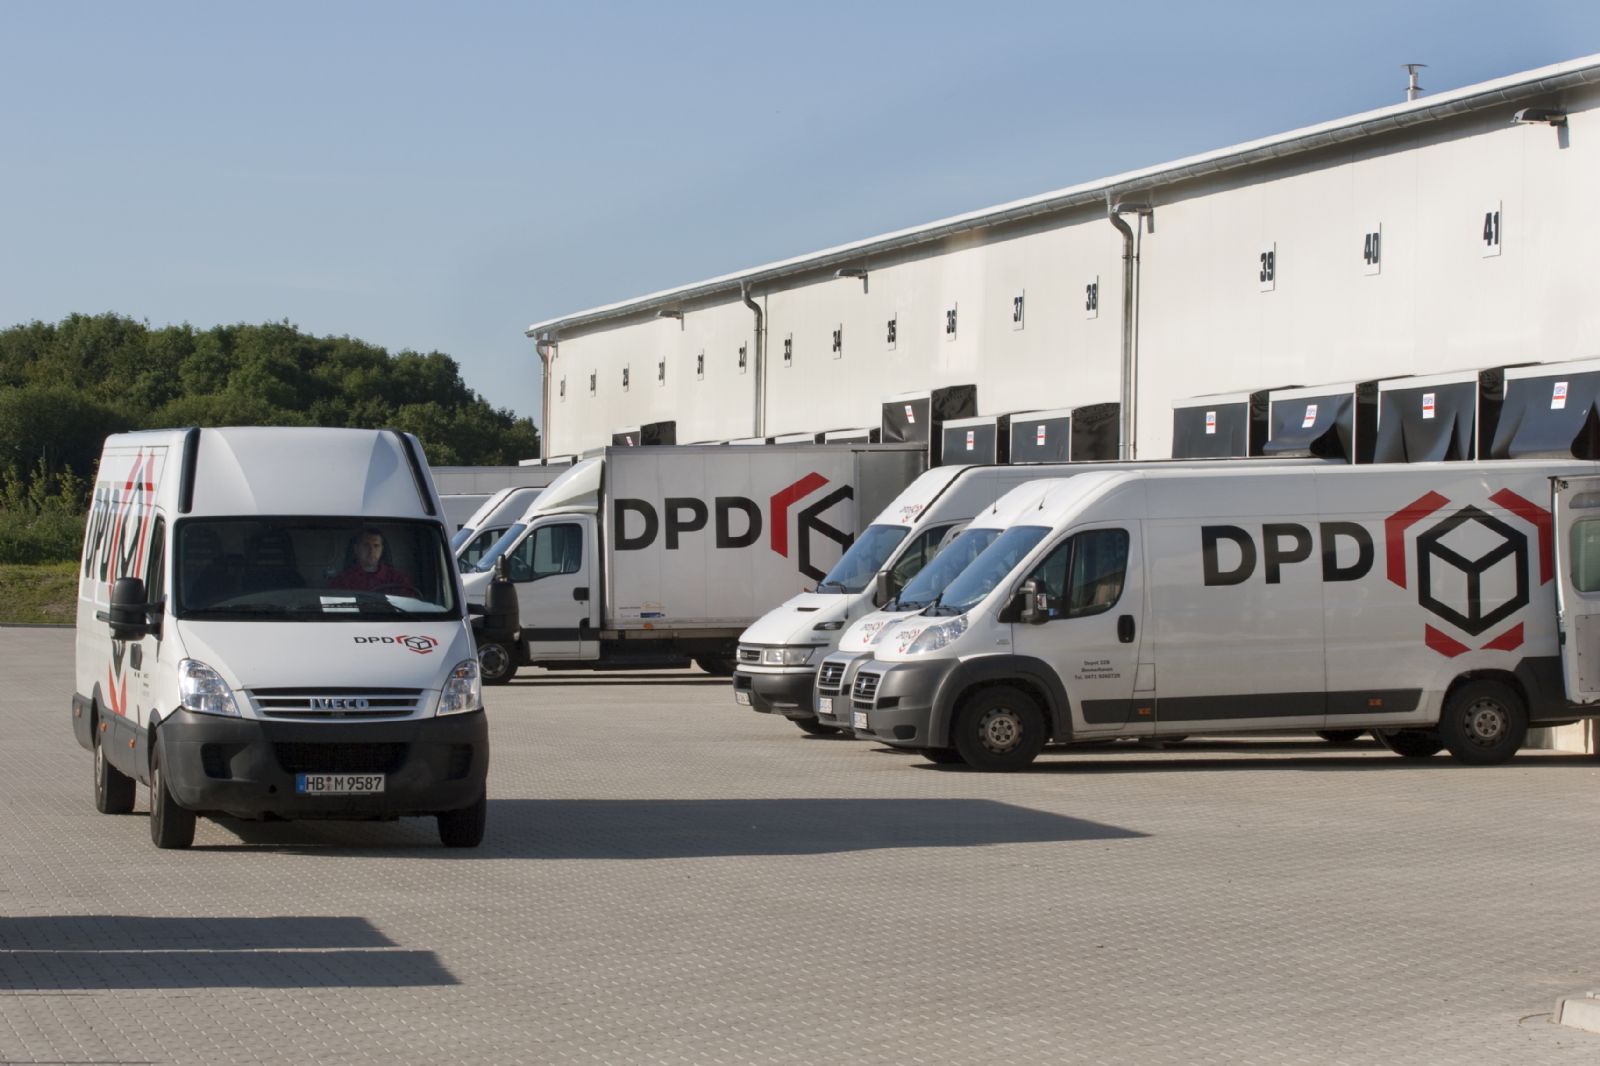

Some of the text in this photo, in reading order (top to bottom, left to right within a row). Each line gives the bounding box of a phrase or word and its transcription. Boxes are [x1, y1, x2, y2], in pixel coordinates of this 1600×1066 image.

[1483, 211, 1499, 246] 41
[1363, 232, 1379, 265] 40
[1260, 251, 1274, 282] 39
[1013, 296, 1023, 322] 37
[1086, 283, 1097, 311] 38
[614, 496, 763, 551] DPD
[1201, 521, 1375, 587] DPD
[353, 636, 395, 644] DPD
[308, 696, 370, 710] IVECO
[306, 776, 382, 791] HB M 9587
